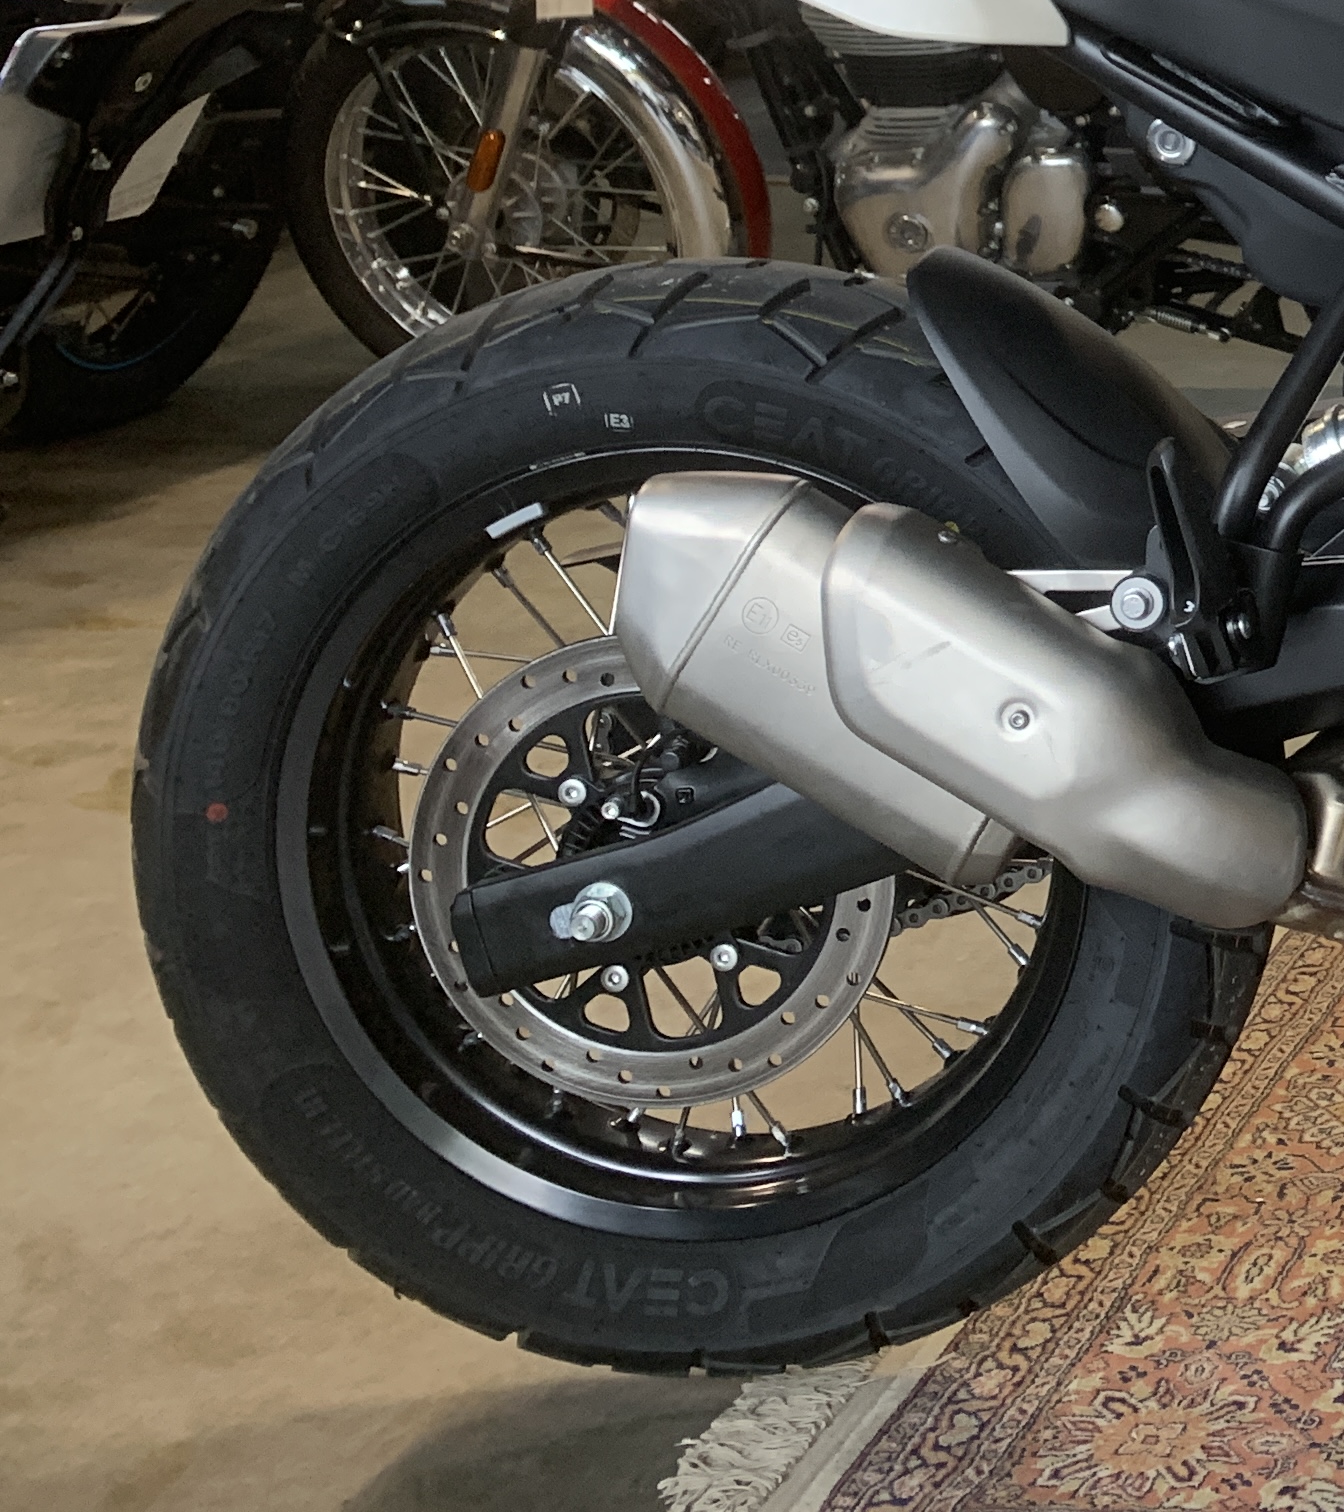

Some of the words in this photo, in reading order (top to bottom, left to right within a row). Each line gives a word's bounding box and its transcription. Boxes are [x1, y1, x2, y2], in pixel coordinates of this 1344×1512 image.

[608, 412, 631, 429] E3
[703, 395, 869, 457] CEAT
[722, 633, 743, 653] RE
[563, 1258, 731, 1317] CEAT
